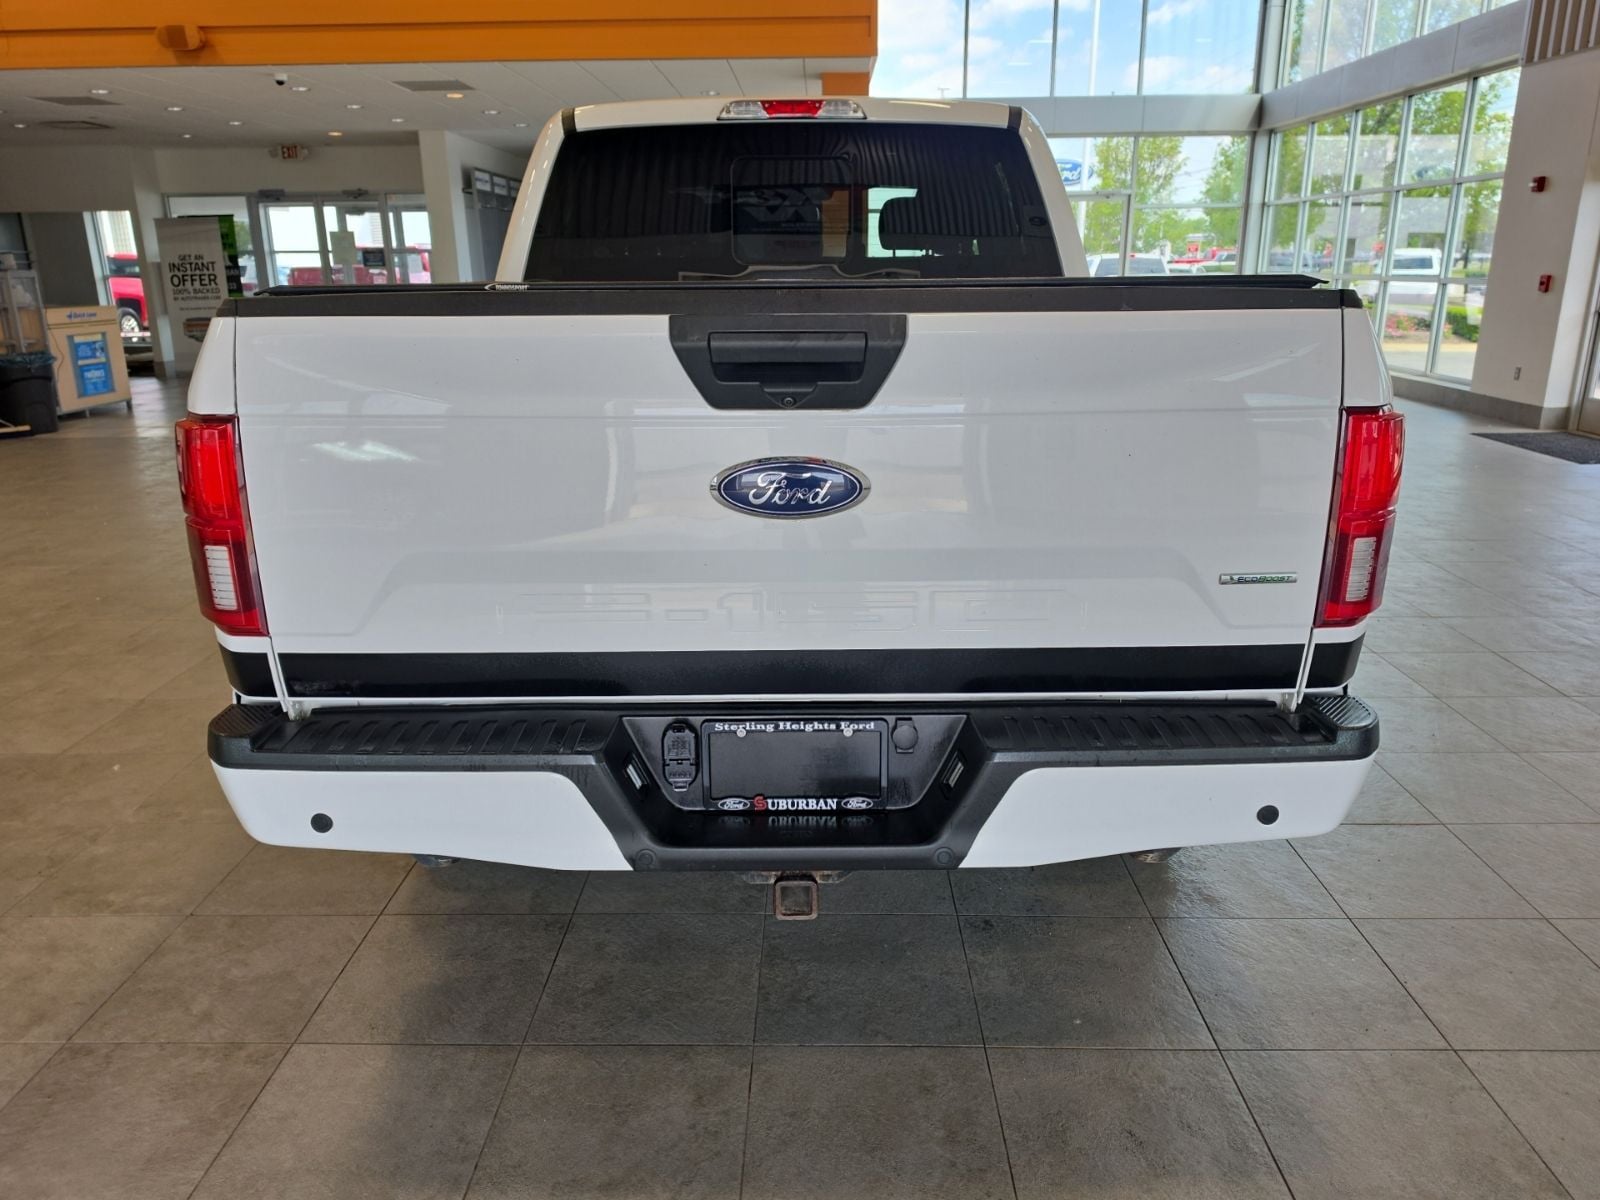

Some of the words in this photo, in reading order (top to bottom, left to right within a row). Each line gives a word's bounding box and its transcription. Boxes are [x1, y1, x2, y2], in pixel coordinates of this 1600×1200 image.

[168, 261, 216, 273] INSTANT
[170, 273, 218, 288] OFFER
[193, 287, 221, 295] BACKED
[748, 471, 833, 505] Ford
[714, 721, 775, 732] Sterling
[778, 721, 836, 732] Heights
[840, 721, 875, 731] Ford
[753, 795, 838, 810] SUBURBAN
